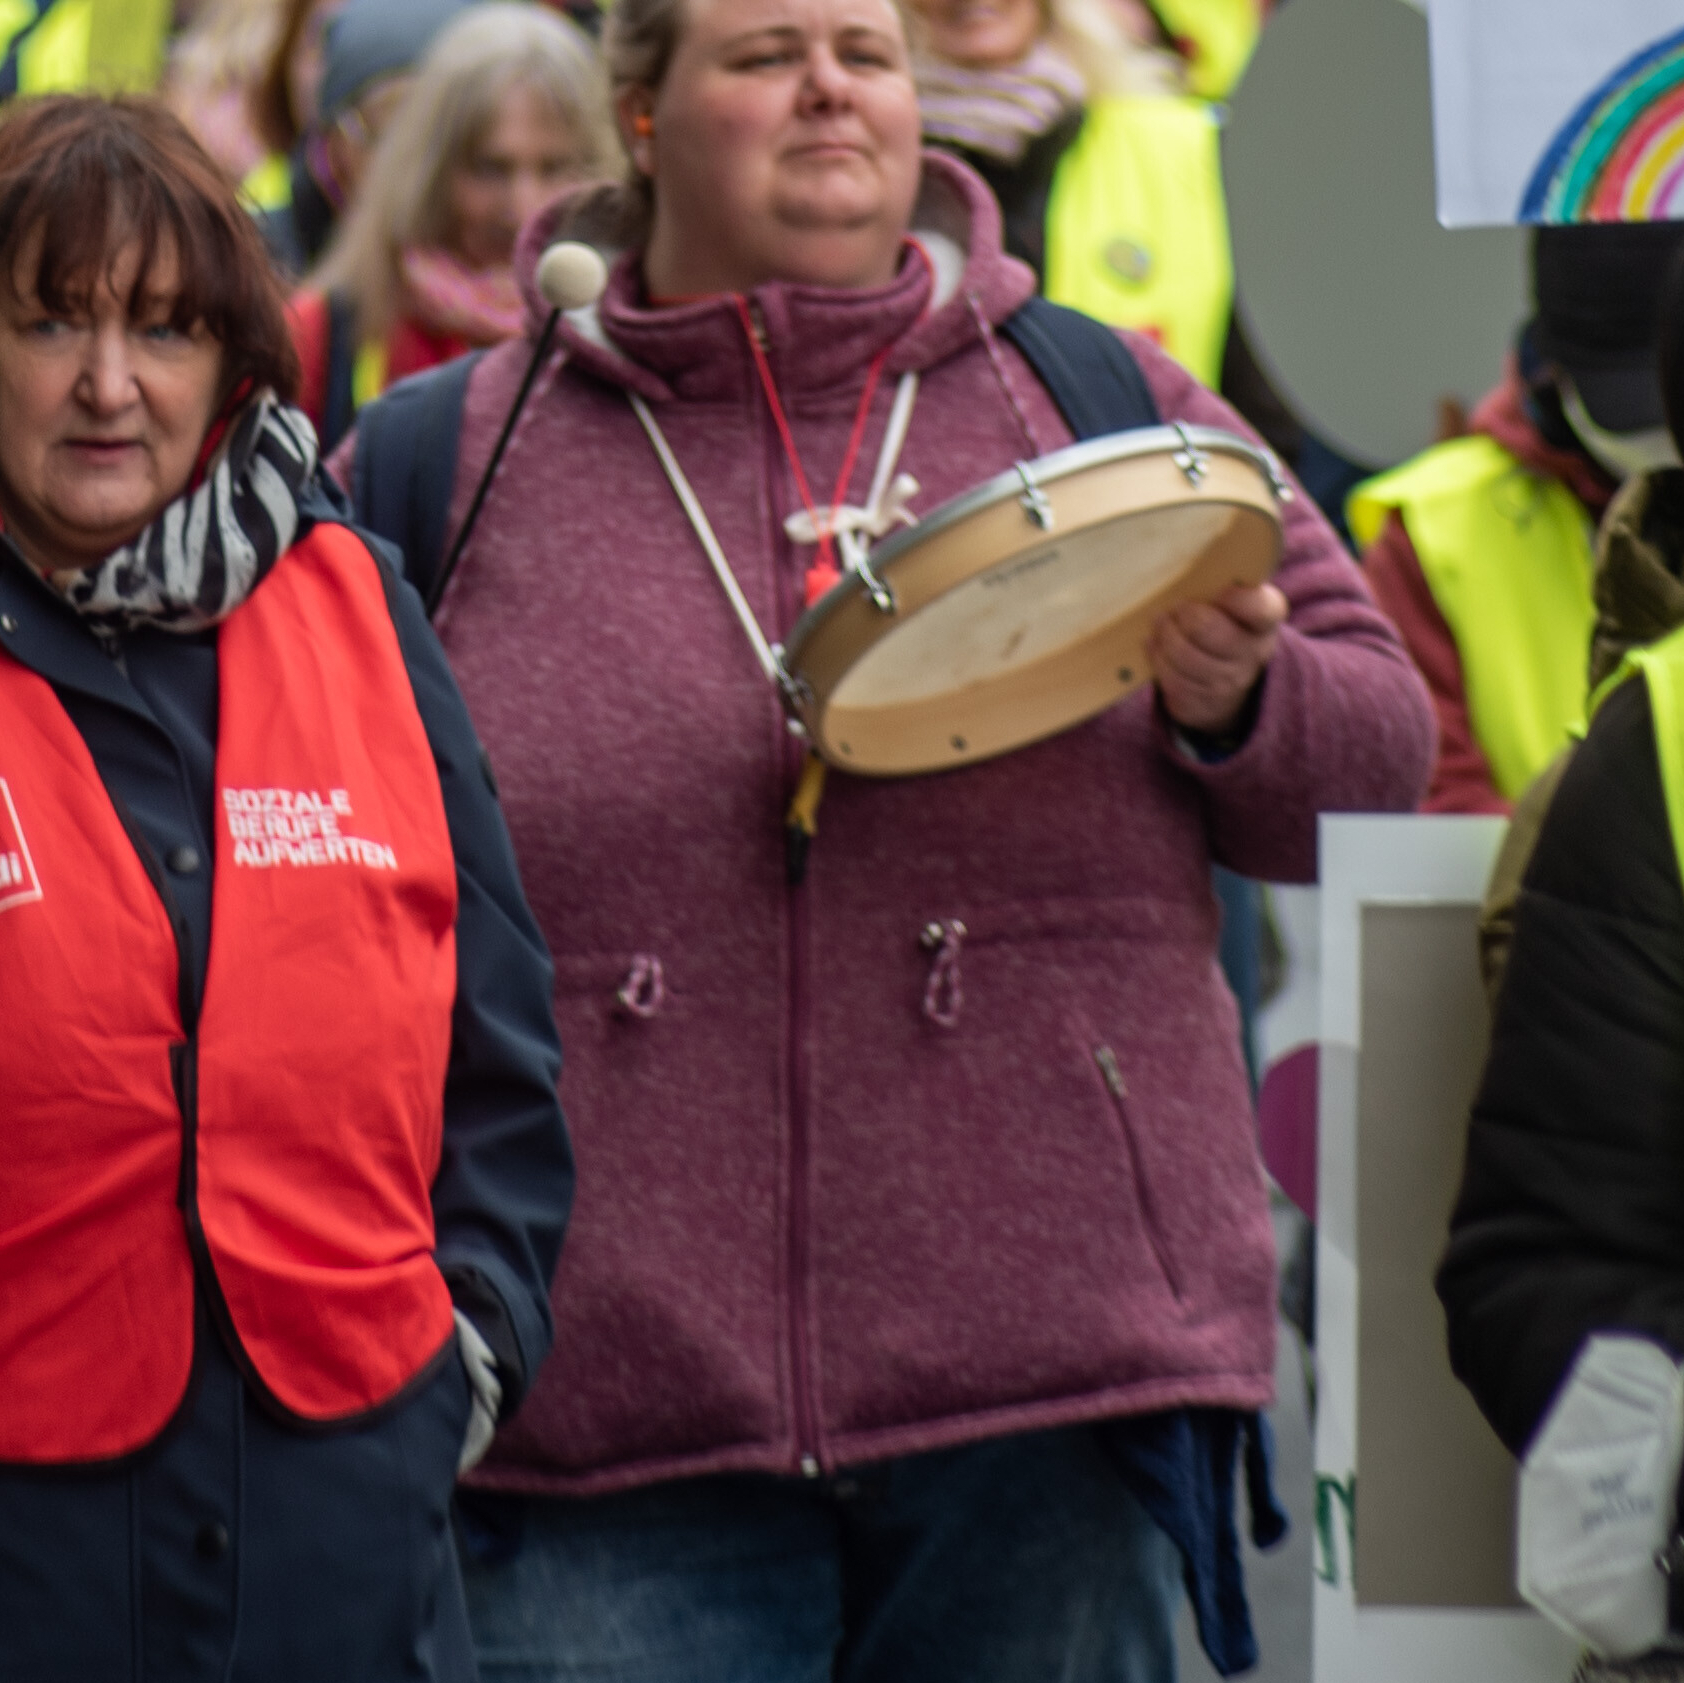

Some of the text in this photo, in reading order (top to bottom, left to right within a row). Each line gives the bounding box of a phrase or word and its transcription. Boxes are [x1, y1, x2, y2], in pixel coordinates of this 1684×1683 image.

[222, 788, 353, 816] SOZIALE
[228, 807, 342, 839] BERUFE
[234, 836, 398, 870] AUFWERTEN
